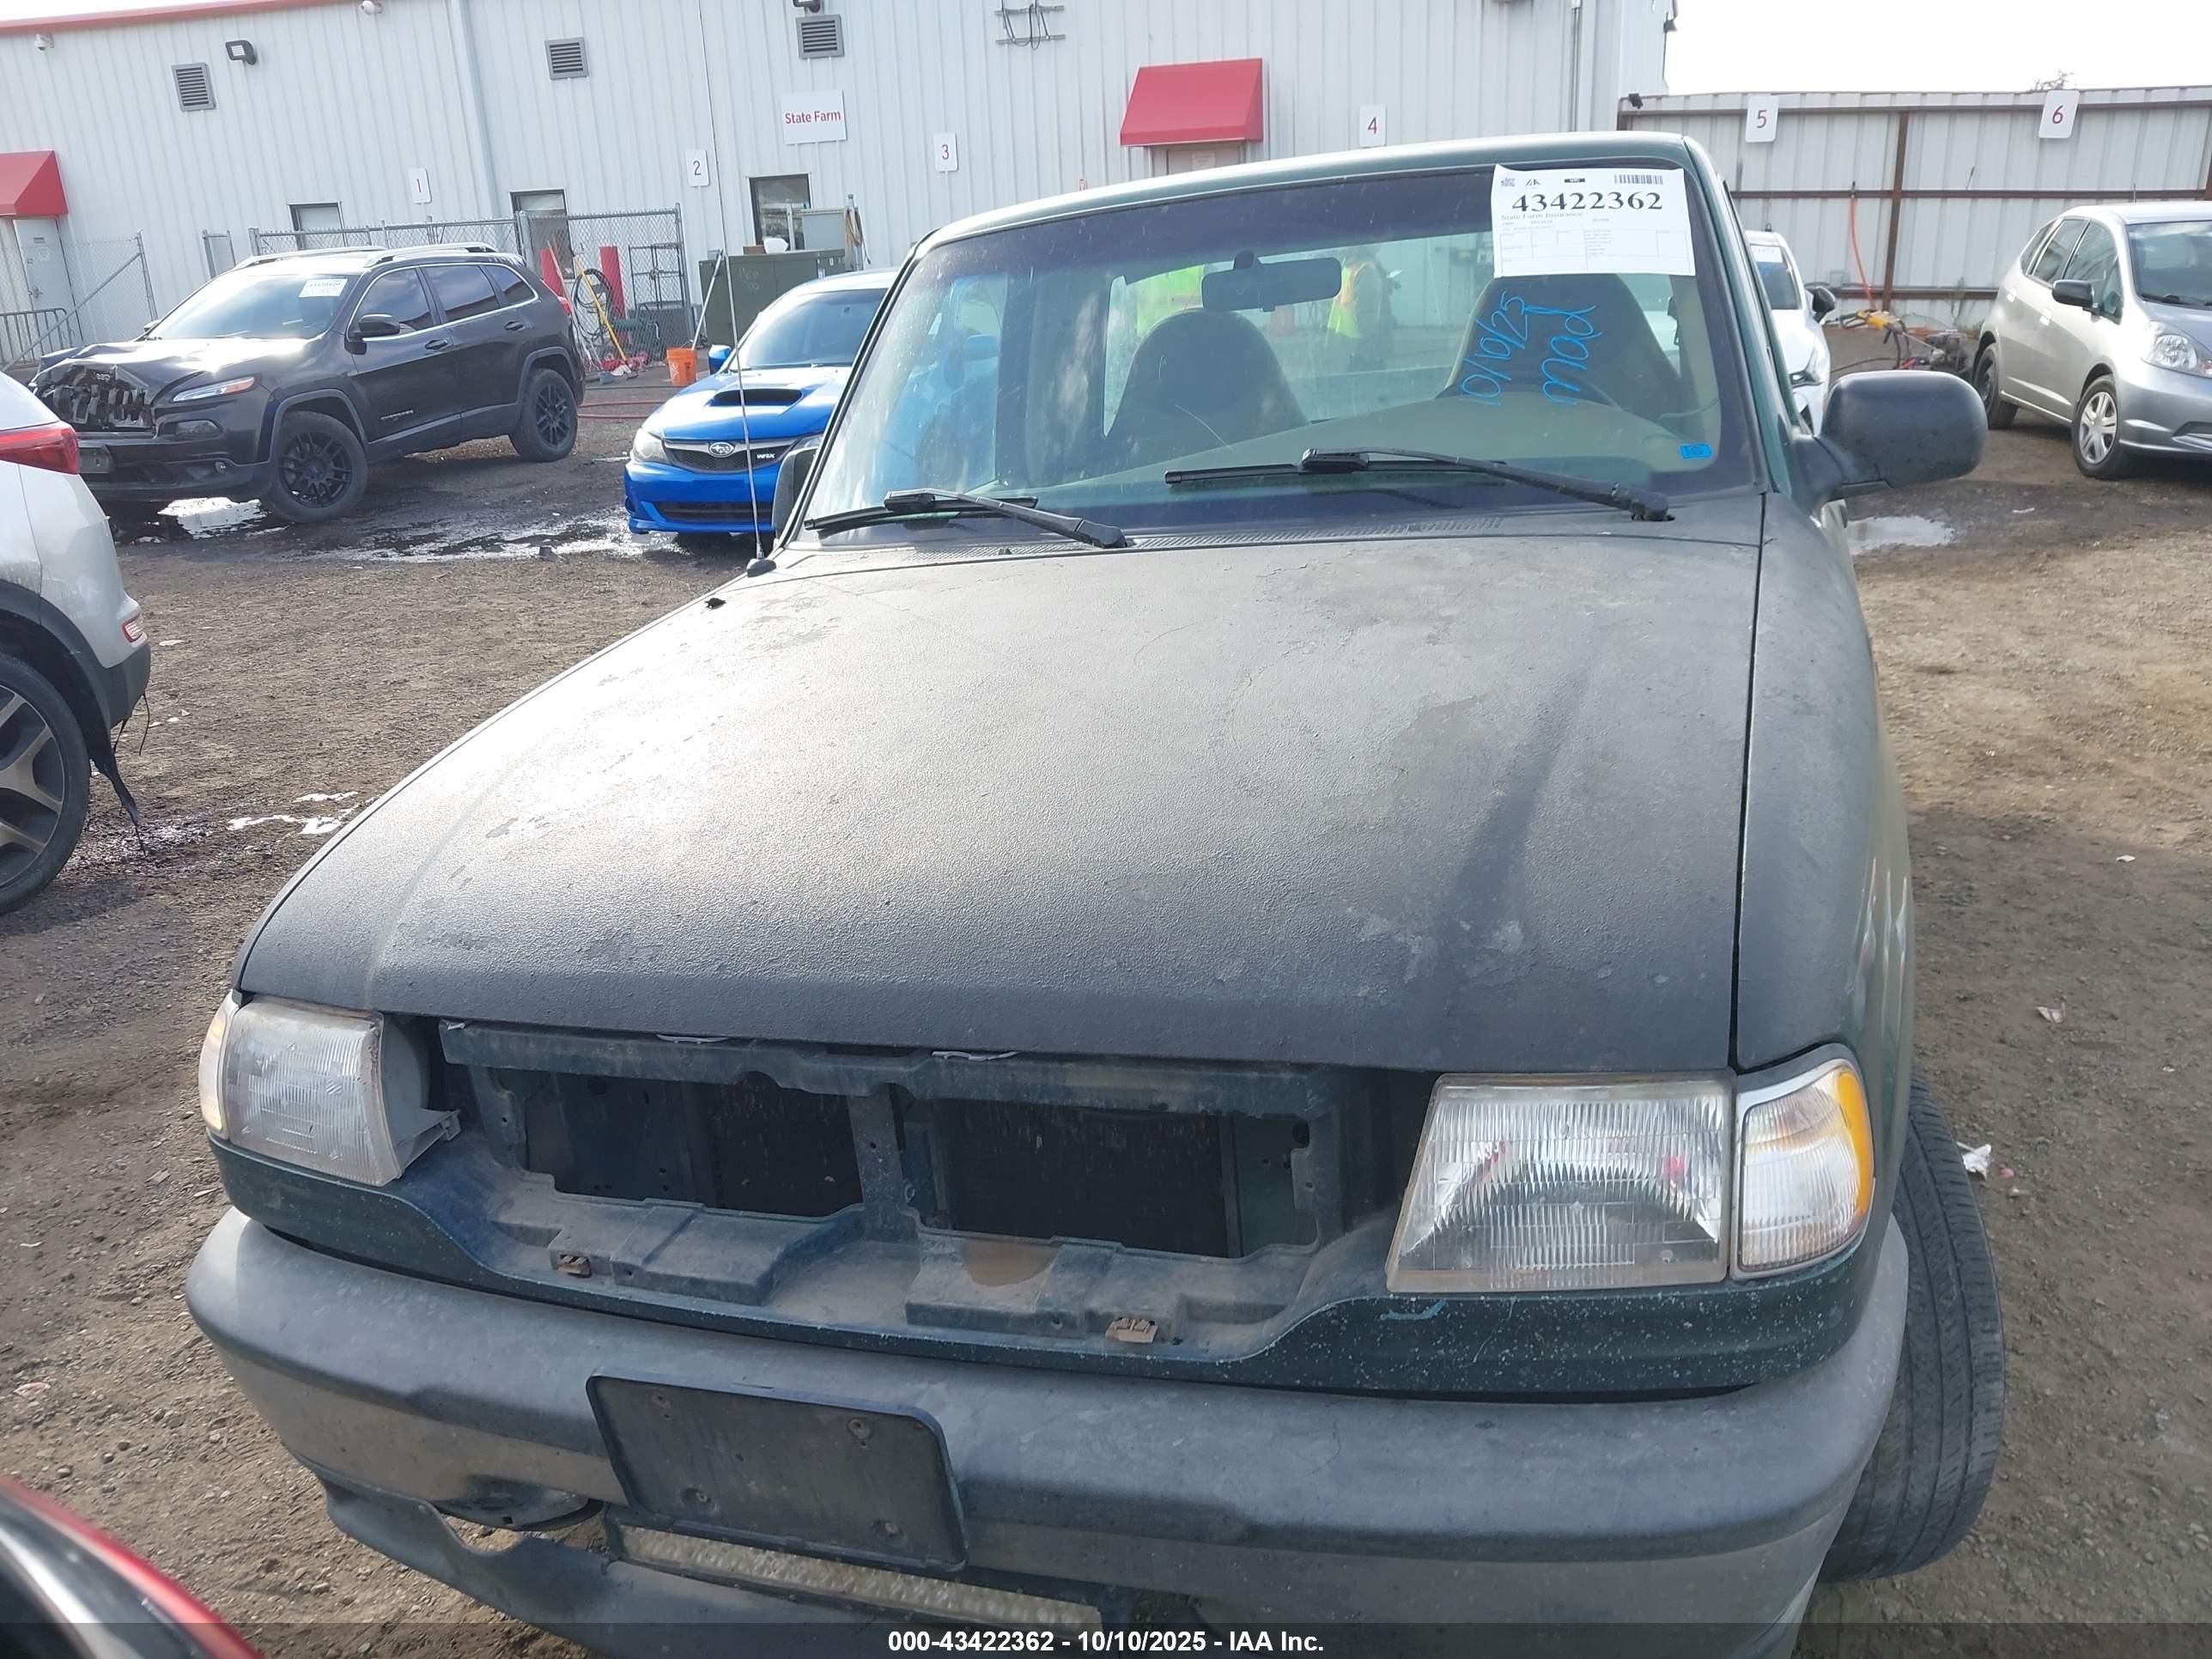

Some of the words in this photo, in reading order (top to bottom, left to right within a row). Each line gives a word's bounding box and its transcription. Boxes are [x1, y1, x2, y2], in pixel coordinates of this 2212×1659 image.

[785, 112, 811, 125] State
[814, 110, 842, 123] Farm
[1756, 109, 1767, 129] 5
[2052, 105, 2063, 124] 6
[1367, 116, 1376, 135] 4
[941, 143, 949, 160] 3
[693, 160, 701, 176] 2
[416, 178, 422, 193] 1
[1511, 191, 1662, 212] 43422362
[1459, 290, 1528, 406] 10/10/25
